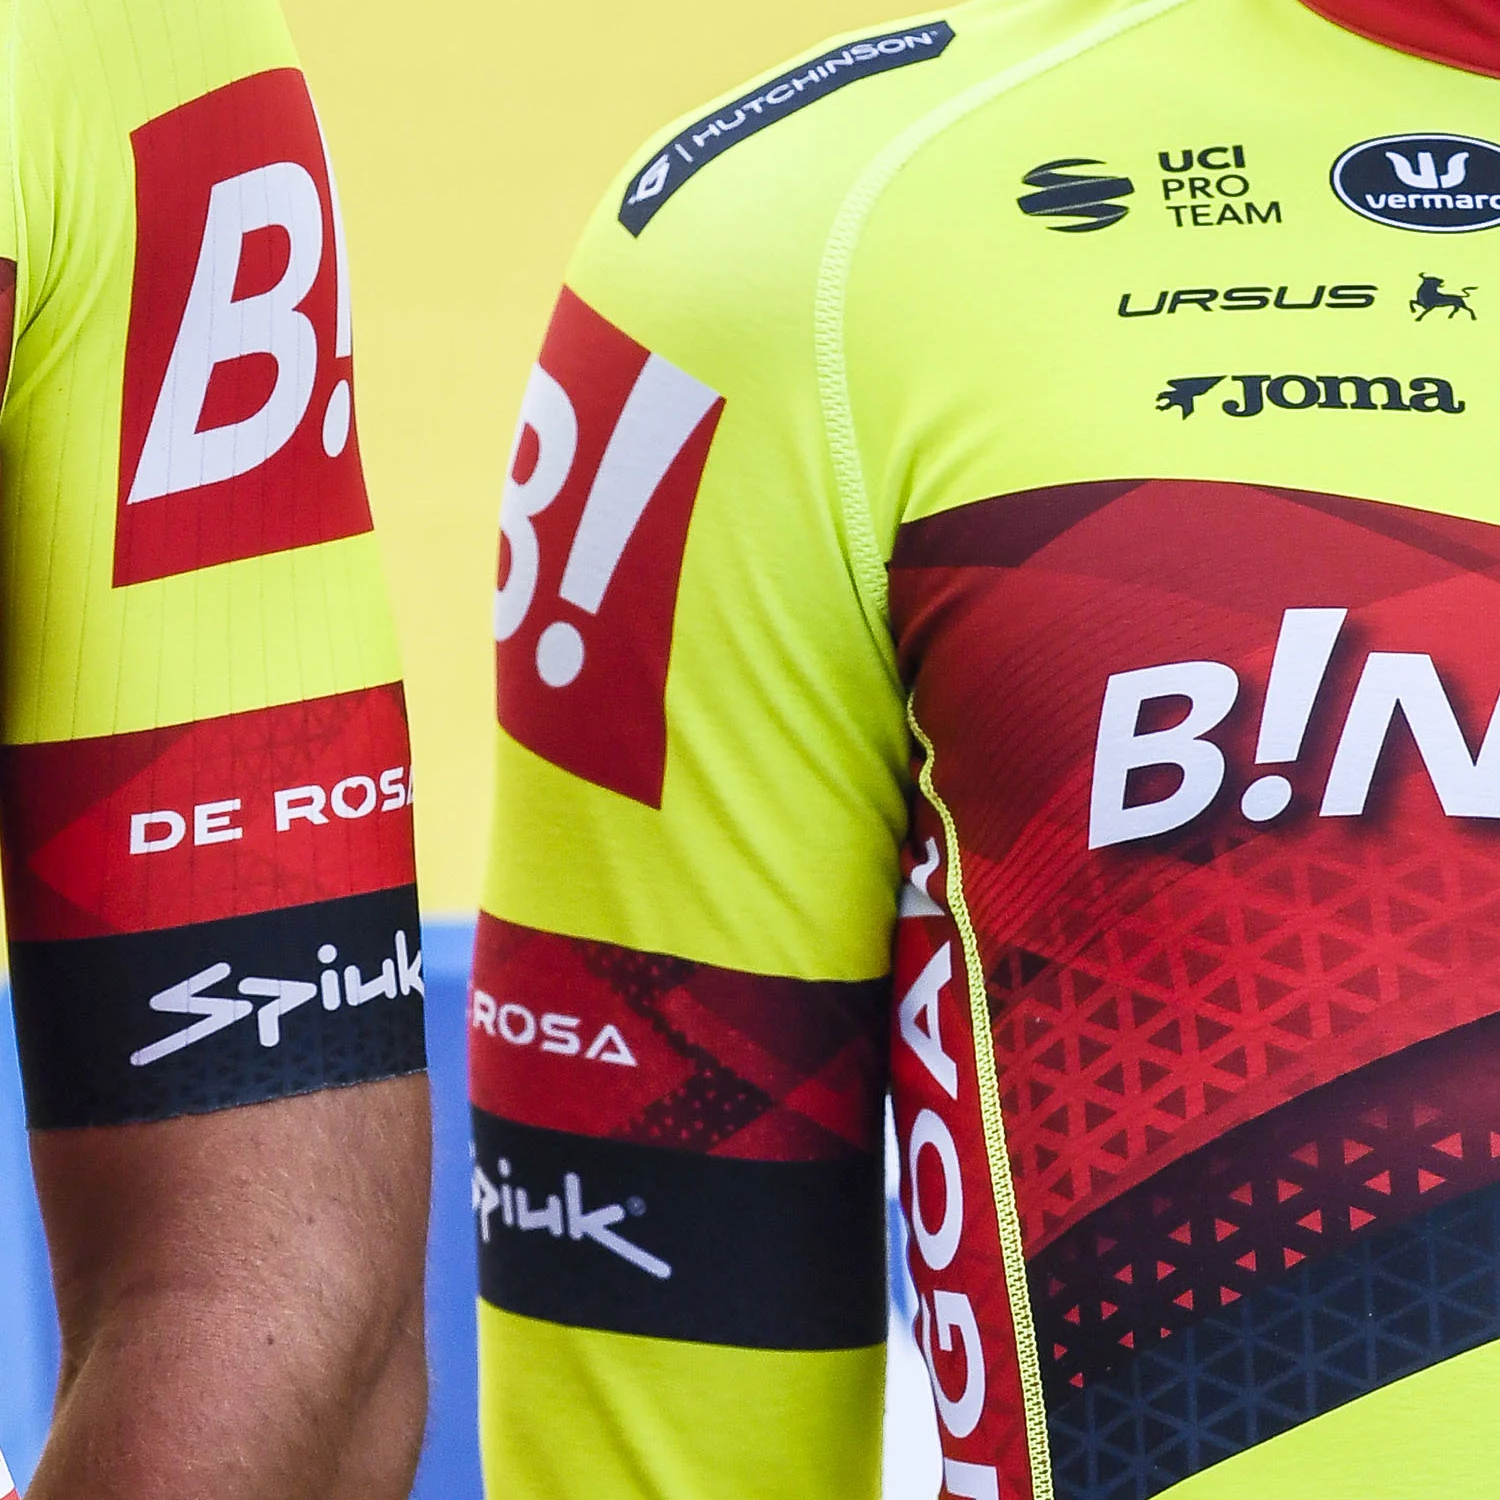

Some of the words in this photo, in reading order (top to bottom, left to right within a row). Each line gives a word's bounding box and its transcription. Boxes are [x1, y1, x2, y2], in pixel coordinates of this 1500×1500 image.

[693, 30, 938, 148] HUTCHINSON
[1158, 145, 1246, 173] UCI
[1162, 174, 1250, 200] PRO
[1166, 202, 1283, 228] TEAM
[1117, 284, 1379, 318] URSUS
[129, 798, 243, 855] DE
[274, 766, 414, 832] ROS
[472, 990, 638, 1067] ROSA
[470, 1140, 674, 1280] piuk
